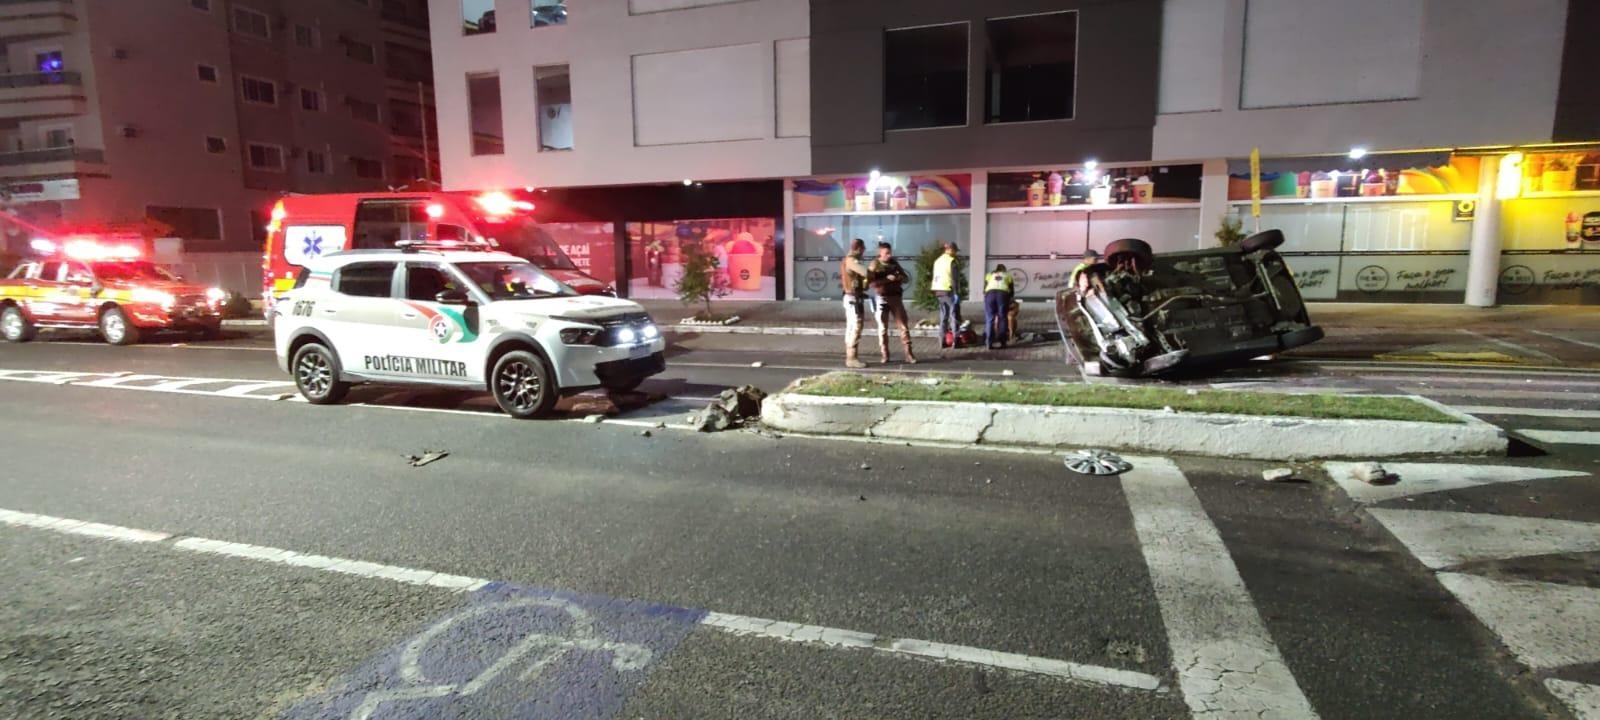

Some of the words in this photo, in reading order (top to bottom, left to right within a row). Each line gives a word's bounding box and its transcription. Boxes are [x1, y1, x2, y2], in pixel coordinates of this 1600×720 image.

[570, 242, 590, 257] AÇAÍ
[364, 354, 413, 373] POLÍCIA
[416, 357, 468, 377] MILITAR
